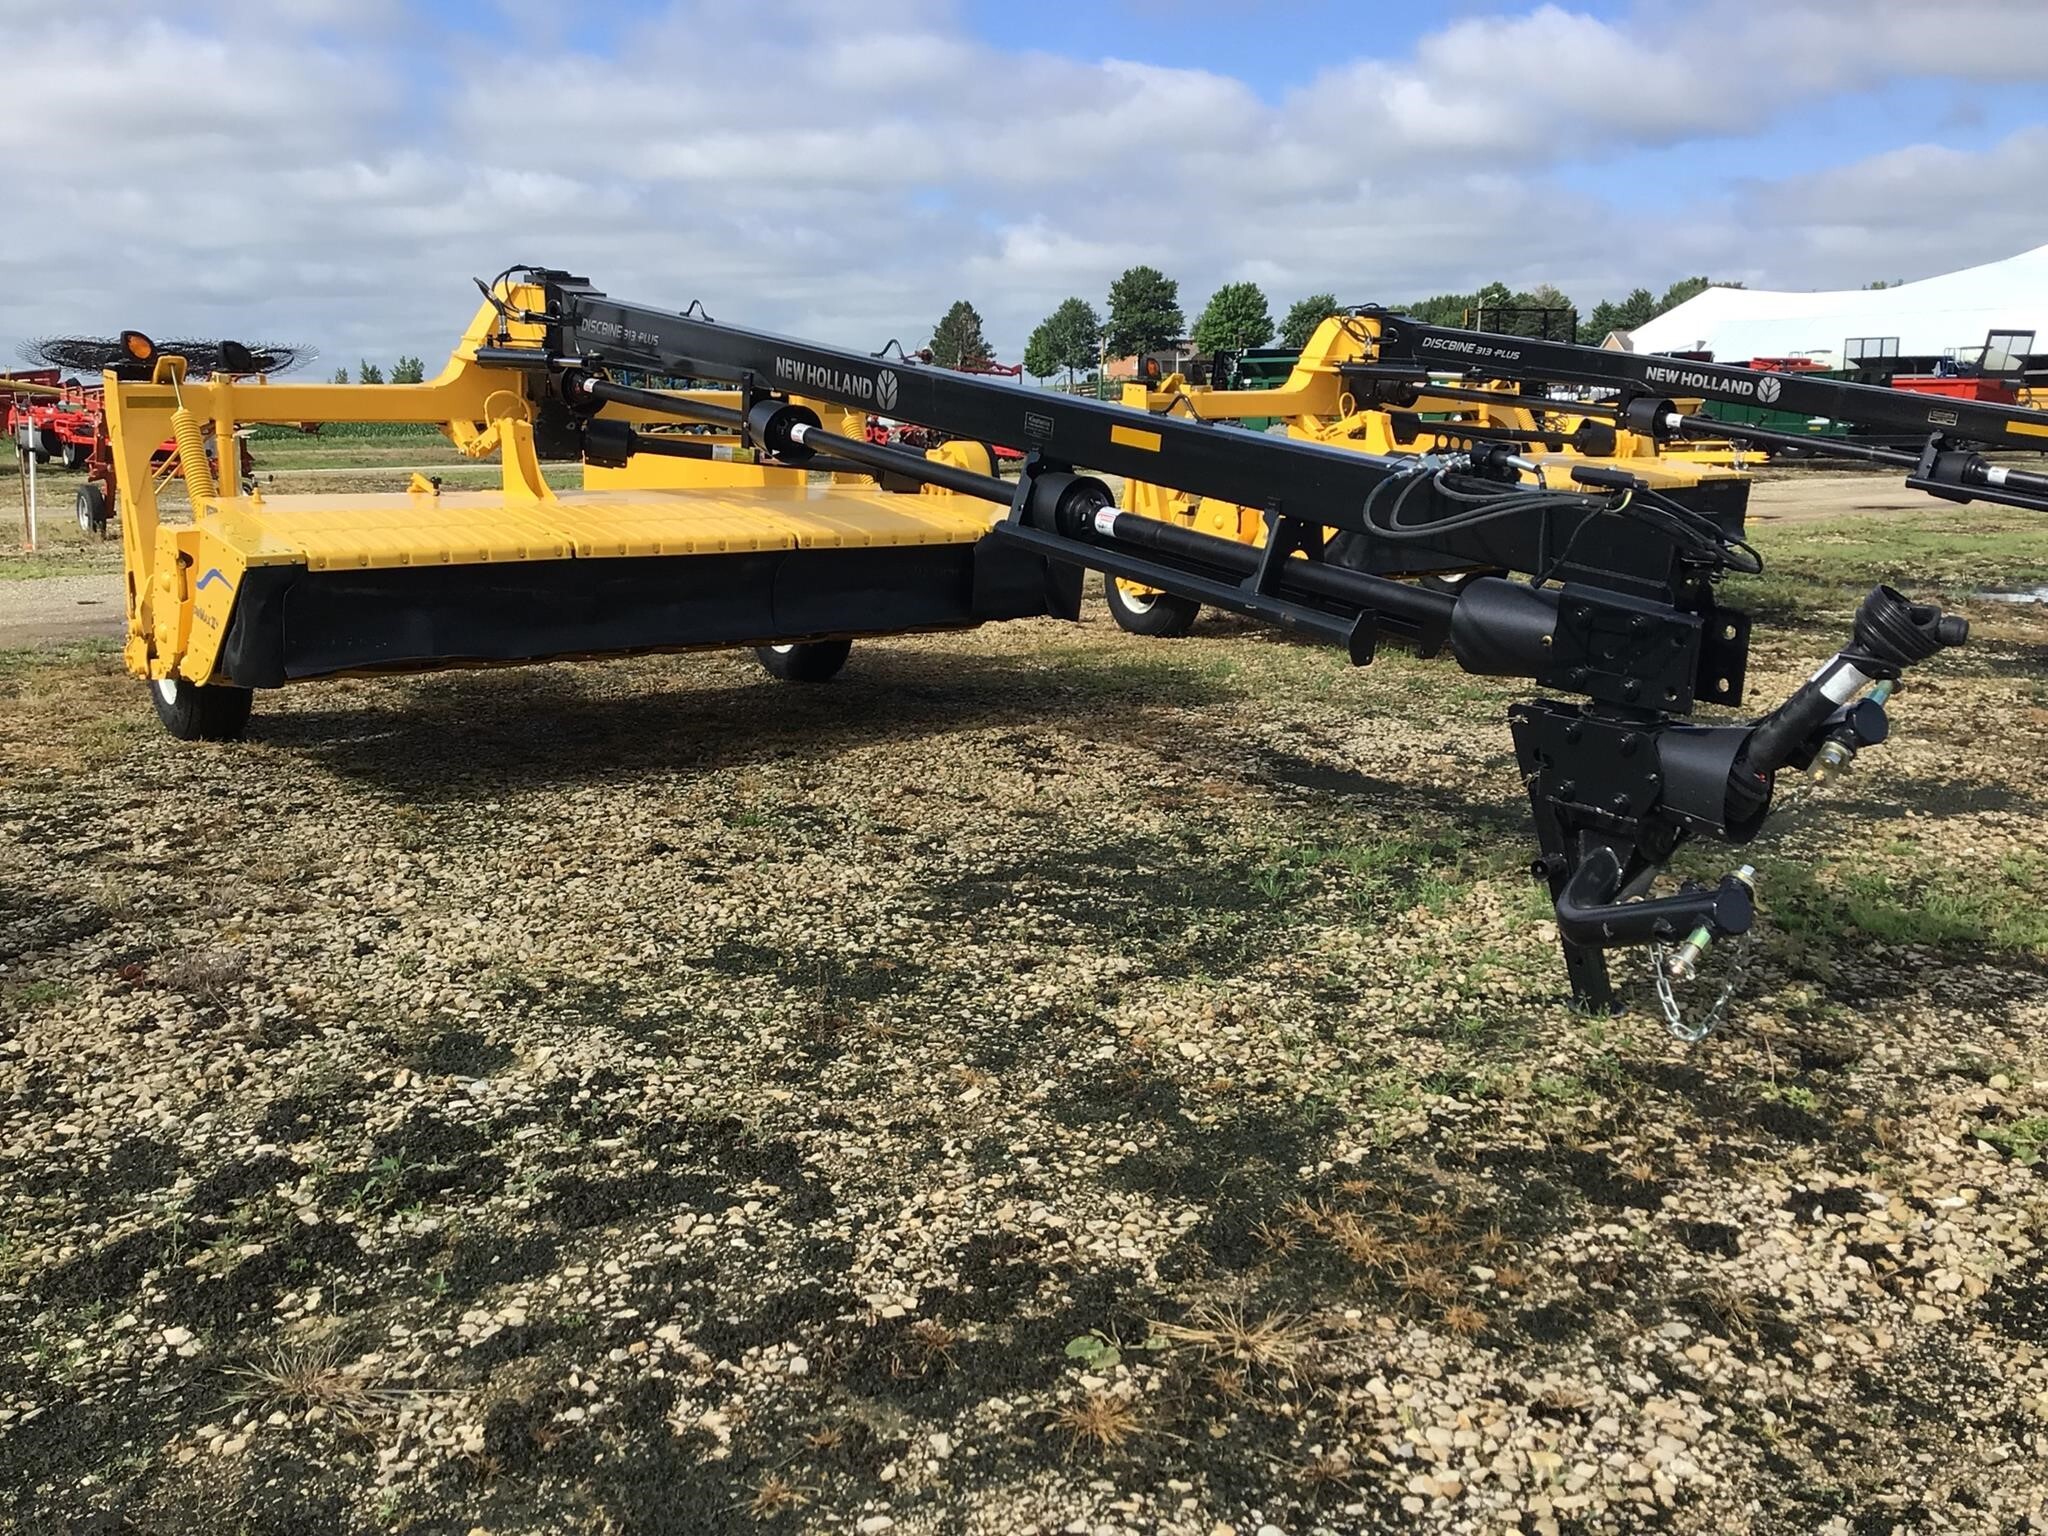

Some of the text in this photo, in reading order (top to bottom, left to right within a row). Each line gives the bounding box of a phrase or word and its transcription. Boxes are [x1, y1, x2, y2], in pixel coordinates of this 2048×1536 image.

[581, 318, 623, 338] DISCBINE
[623, 329, 637, 342] 313
[1421, 337, 1476, 354] DISCBINE
[1475, 346, 1493, 356] 313
[776, 356, 873, 399] NEW HOLLAND
[1645, 366, 1754, 396] NEW HOLLAND
